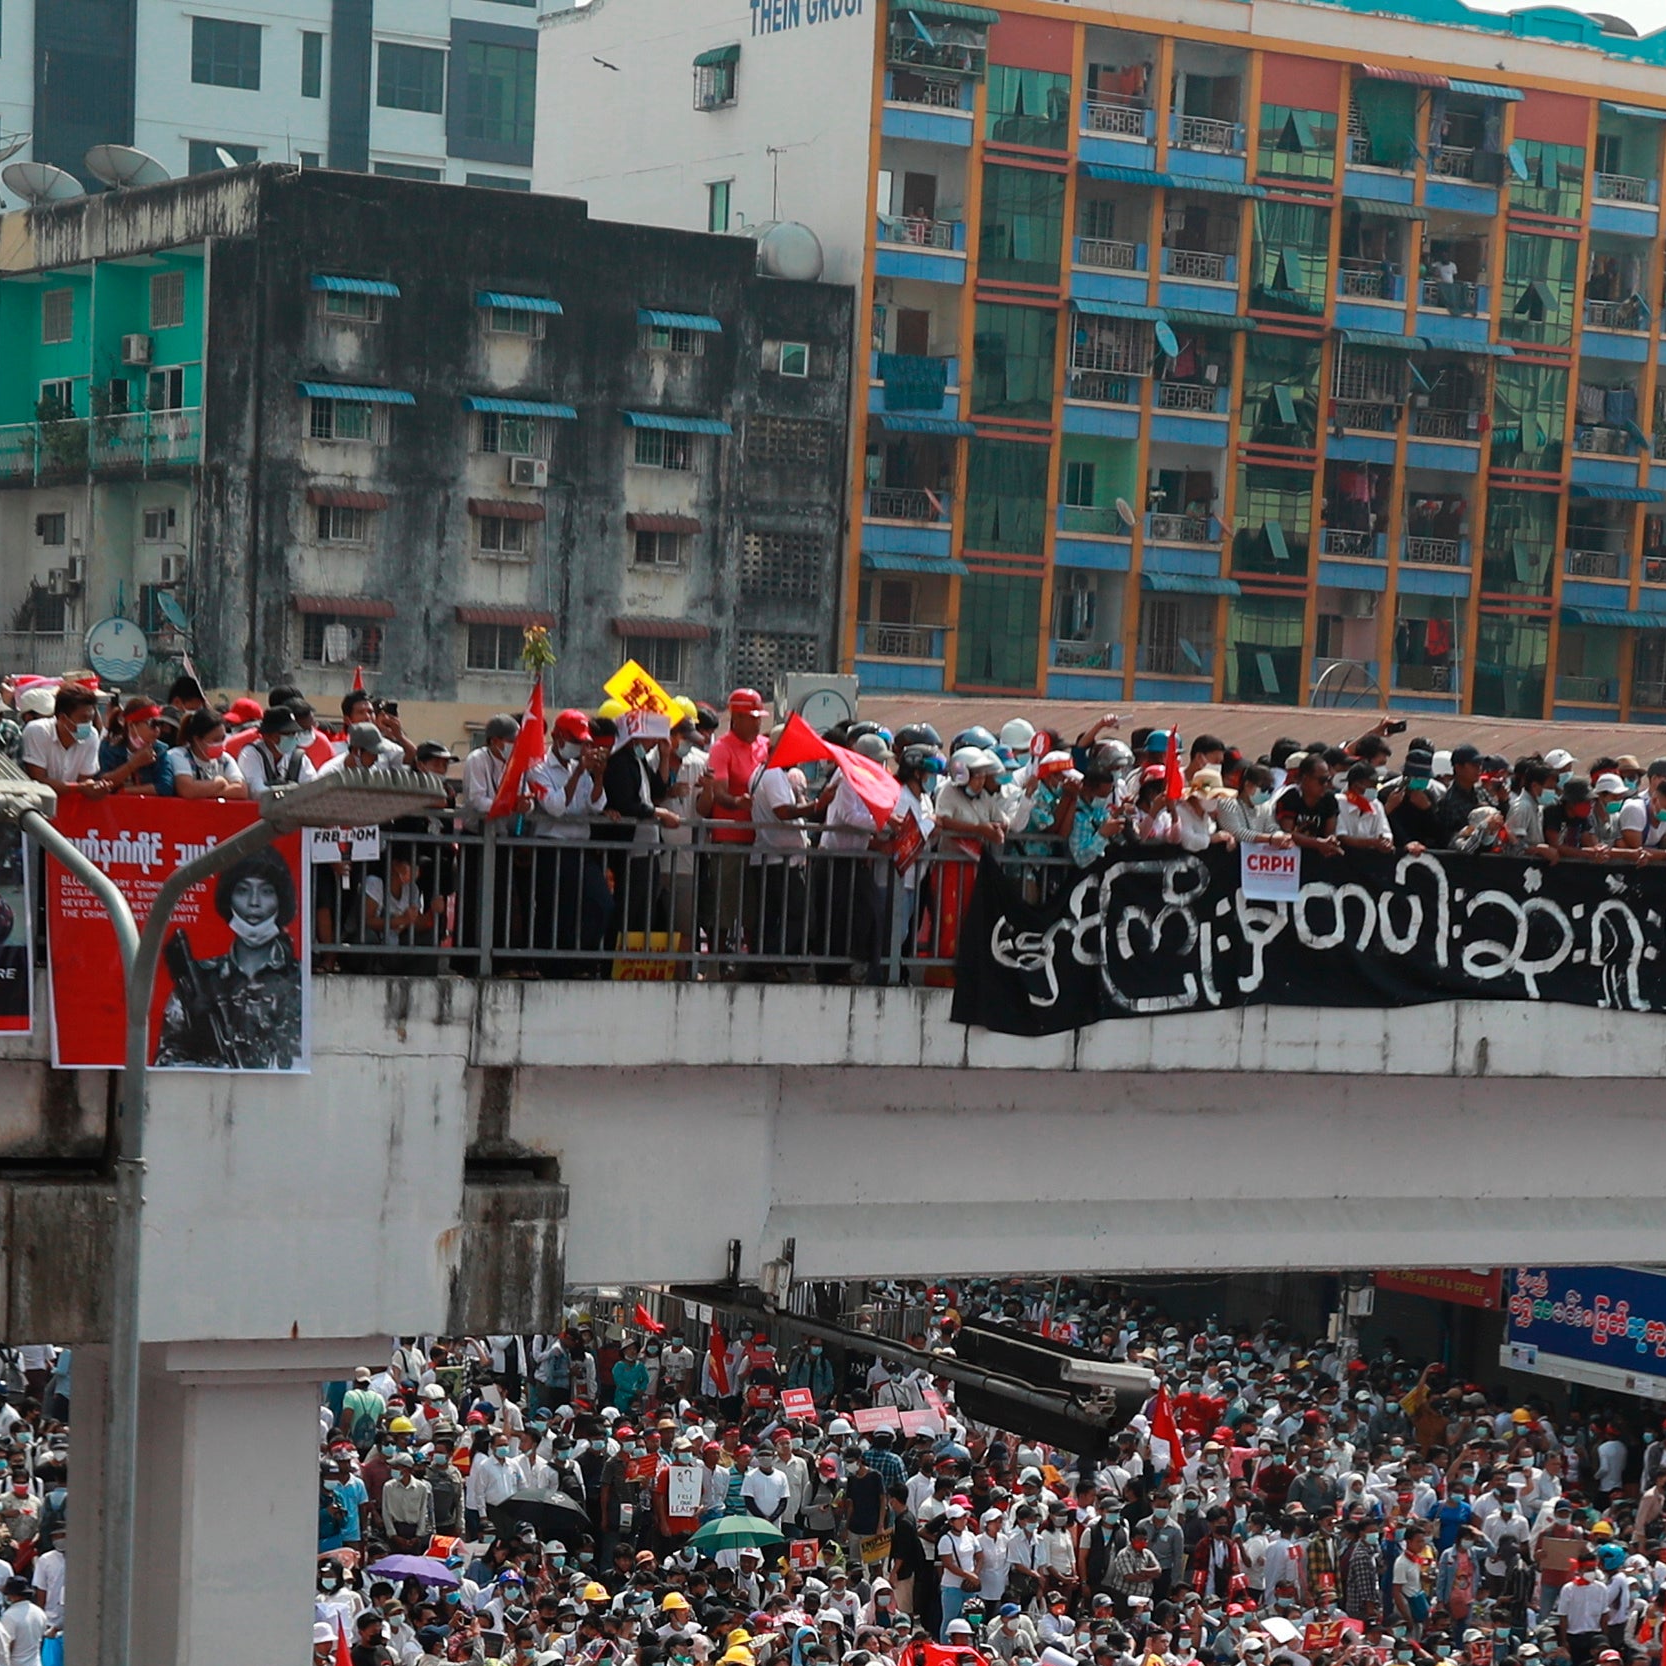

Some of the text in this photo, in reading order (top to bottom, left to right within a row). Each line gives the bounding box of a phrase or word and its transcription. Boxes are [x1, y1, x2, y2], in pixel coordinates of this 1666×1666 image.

[115, 622, 124, 635] P
[93, 642, 143, 658] C L
[1247, 854, 1295, 873] CRPH
